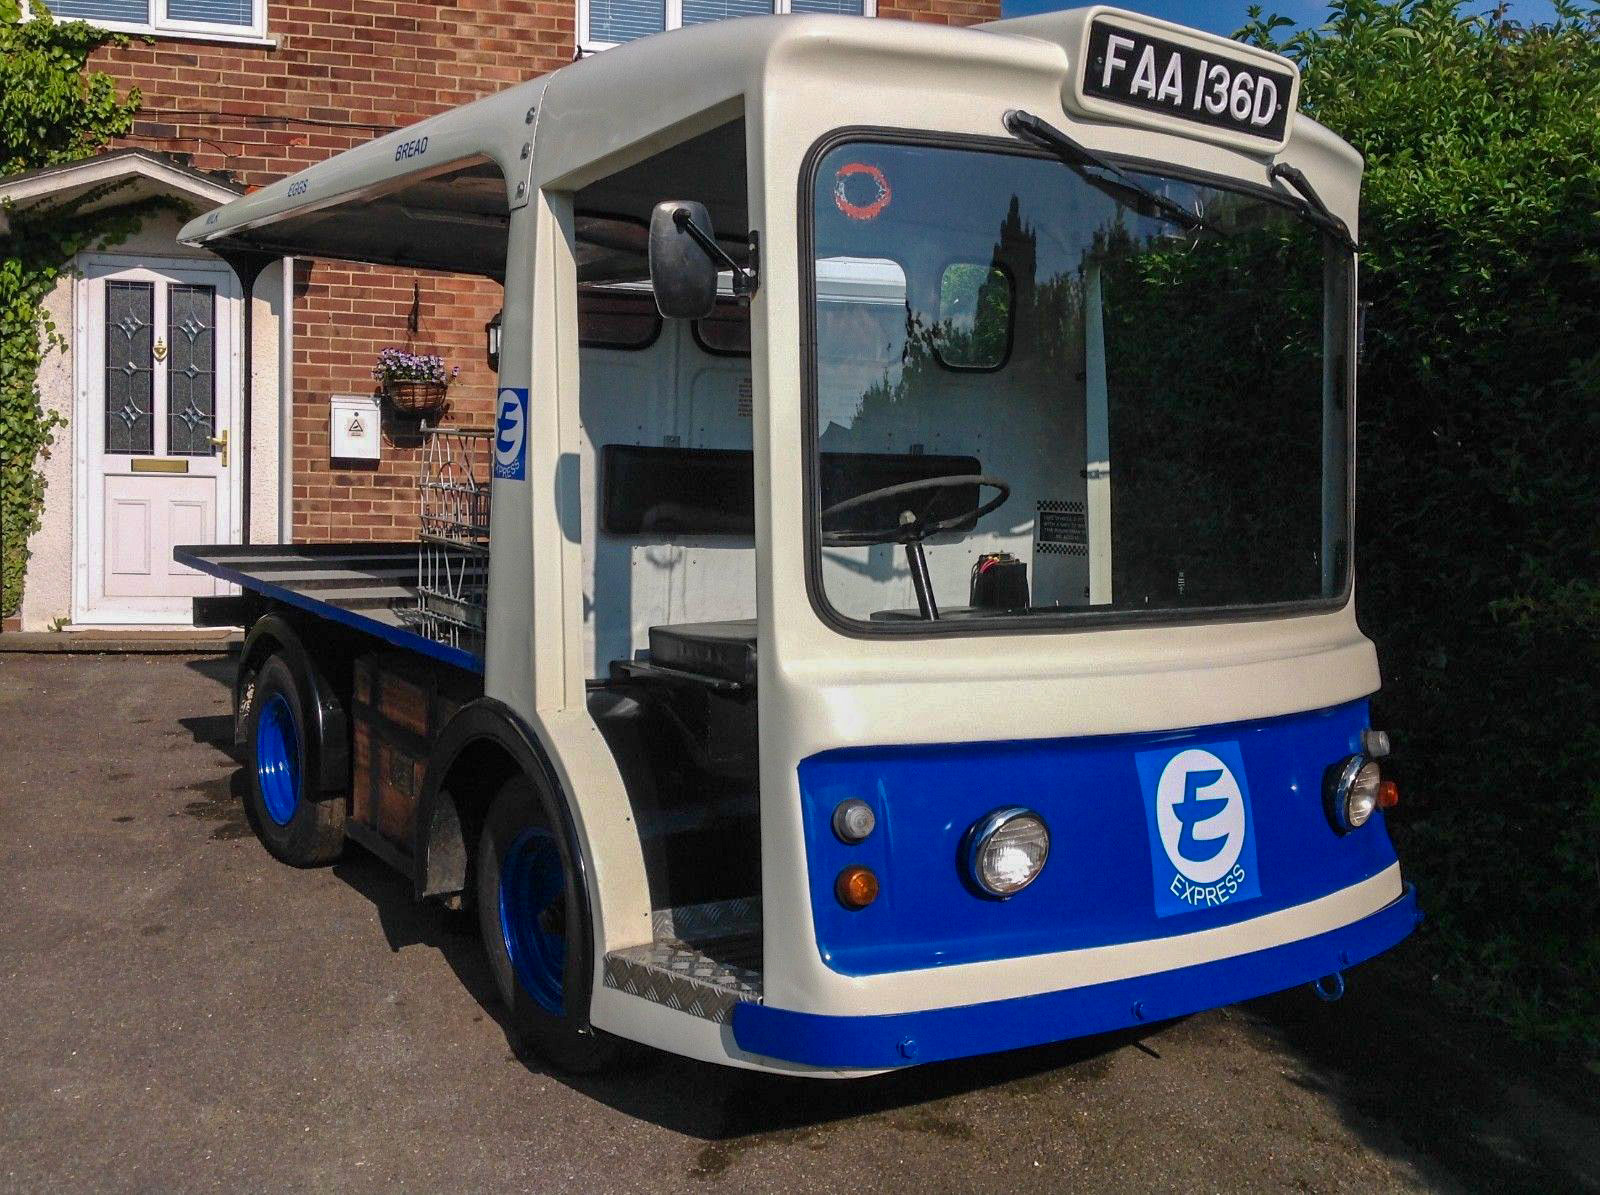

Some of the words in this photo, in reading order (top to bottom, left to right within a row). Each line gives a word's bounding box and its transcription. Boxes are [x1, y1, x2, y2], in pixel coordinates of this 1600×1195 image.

[1102, 34, 1183, 107] FAA
[1193, 59, 1278, 128] 136D
[395, 136, 428, 162] BREAD
[287, 179, 309, 197] EGGS
[1170, 864, 1246, 907] EXPRESS
